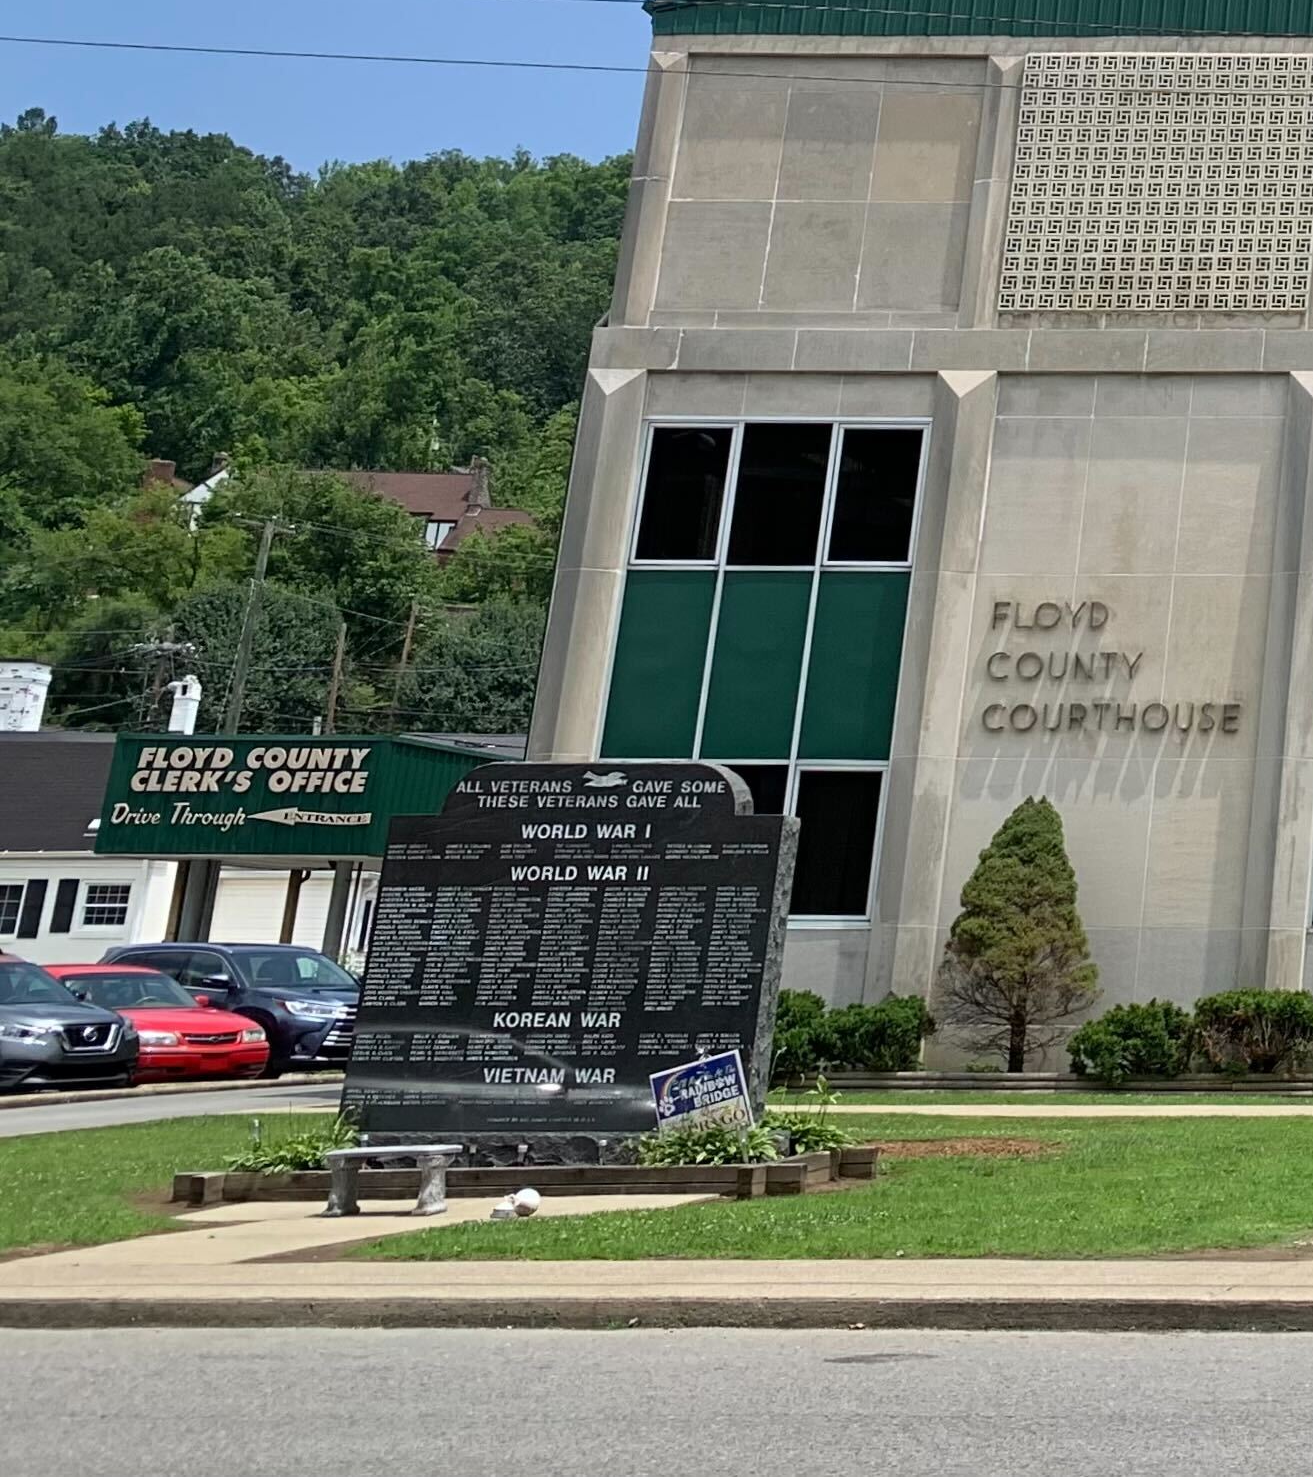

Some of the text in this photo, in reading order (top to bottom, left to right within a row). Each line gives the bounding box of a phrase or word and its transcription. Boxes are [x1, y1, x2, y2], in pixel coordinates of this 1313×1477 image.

[992, 601, 1109, 630] FLOYD
[987, 652, 1143, 680] COUNTY
[982, 703, 1241, 733] COURTHOUSE
[137, 747, 371, 770] FLOYD COUNTY
[130, 770, 369, 793] CLERK'S OFFICE
[456, 780, 726, 793] ALL VETERANS GAVE SOME
[477, 795, 702, 808] THESE VETERANS GAVE ALL
[110, 802, 246, 832] Drive Through
[283, 811, 368, 823] ENTRANCE
[521, 824, 652, 839] WORLD WAR I
[510, 866, 649, 881] WORLD WAR II
[493, 1013, 621, 1028] KOREAN WAR
[483, 1068, 615, 1084] VIETNAM WAR
[693, 1085, 740, 1108] BRIDGE
